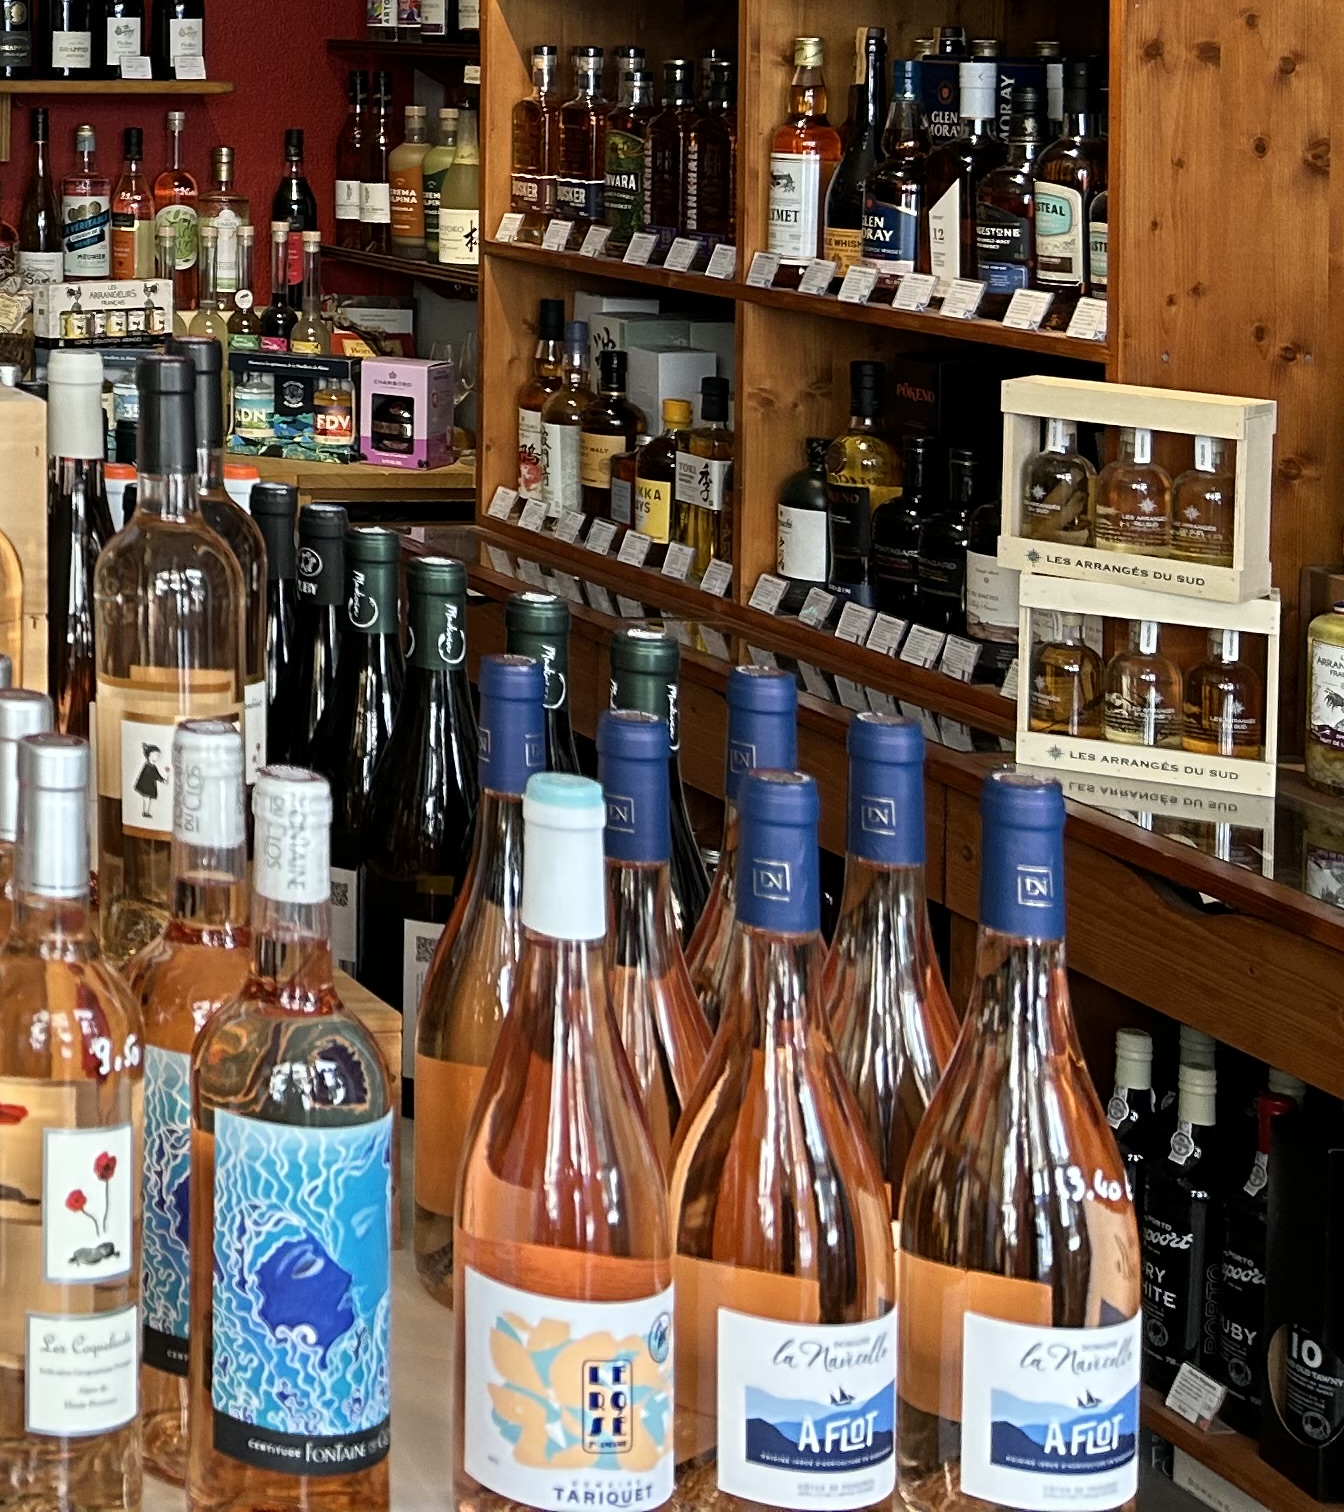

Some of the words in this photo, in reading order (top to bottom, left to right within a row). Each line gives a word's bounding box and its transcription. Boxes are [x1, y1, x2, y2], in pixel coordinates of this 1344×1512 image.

[932, 112, 958, 124] GLEN
[933, 228, 944, 240] 12
[1046, 555, 1071, 566] LES
[1075, 558, 1149, 578] ARRANGÉS
[1153, 571, 1172, 581] DU
[1177, 574, 1205, 587] SUD
[1069, 750, 1095, 762] LES
[1100, 755, 1178, 773] ARRANGÉS
[1184, 765, 1203, 775] DU
[1209, 769, 1239, 780] SUD
[1291, 1332, 1323, 1368] 10
[825, 1411, 879, 1453] FLOT
[1072, 1414, 1124, 1456] FLOT
[554, 1486, 653, 1508] TARIQUET
